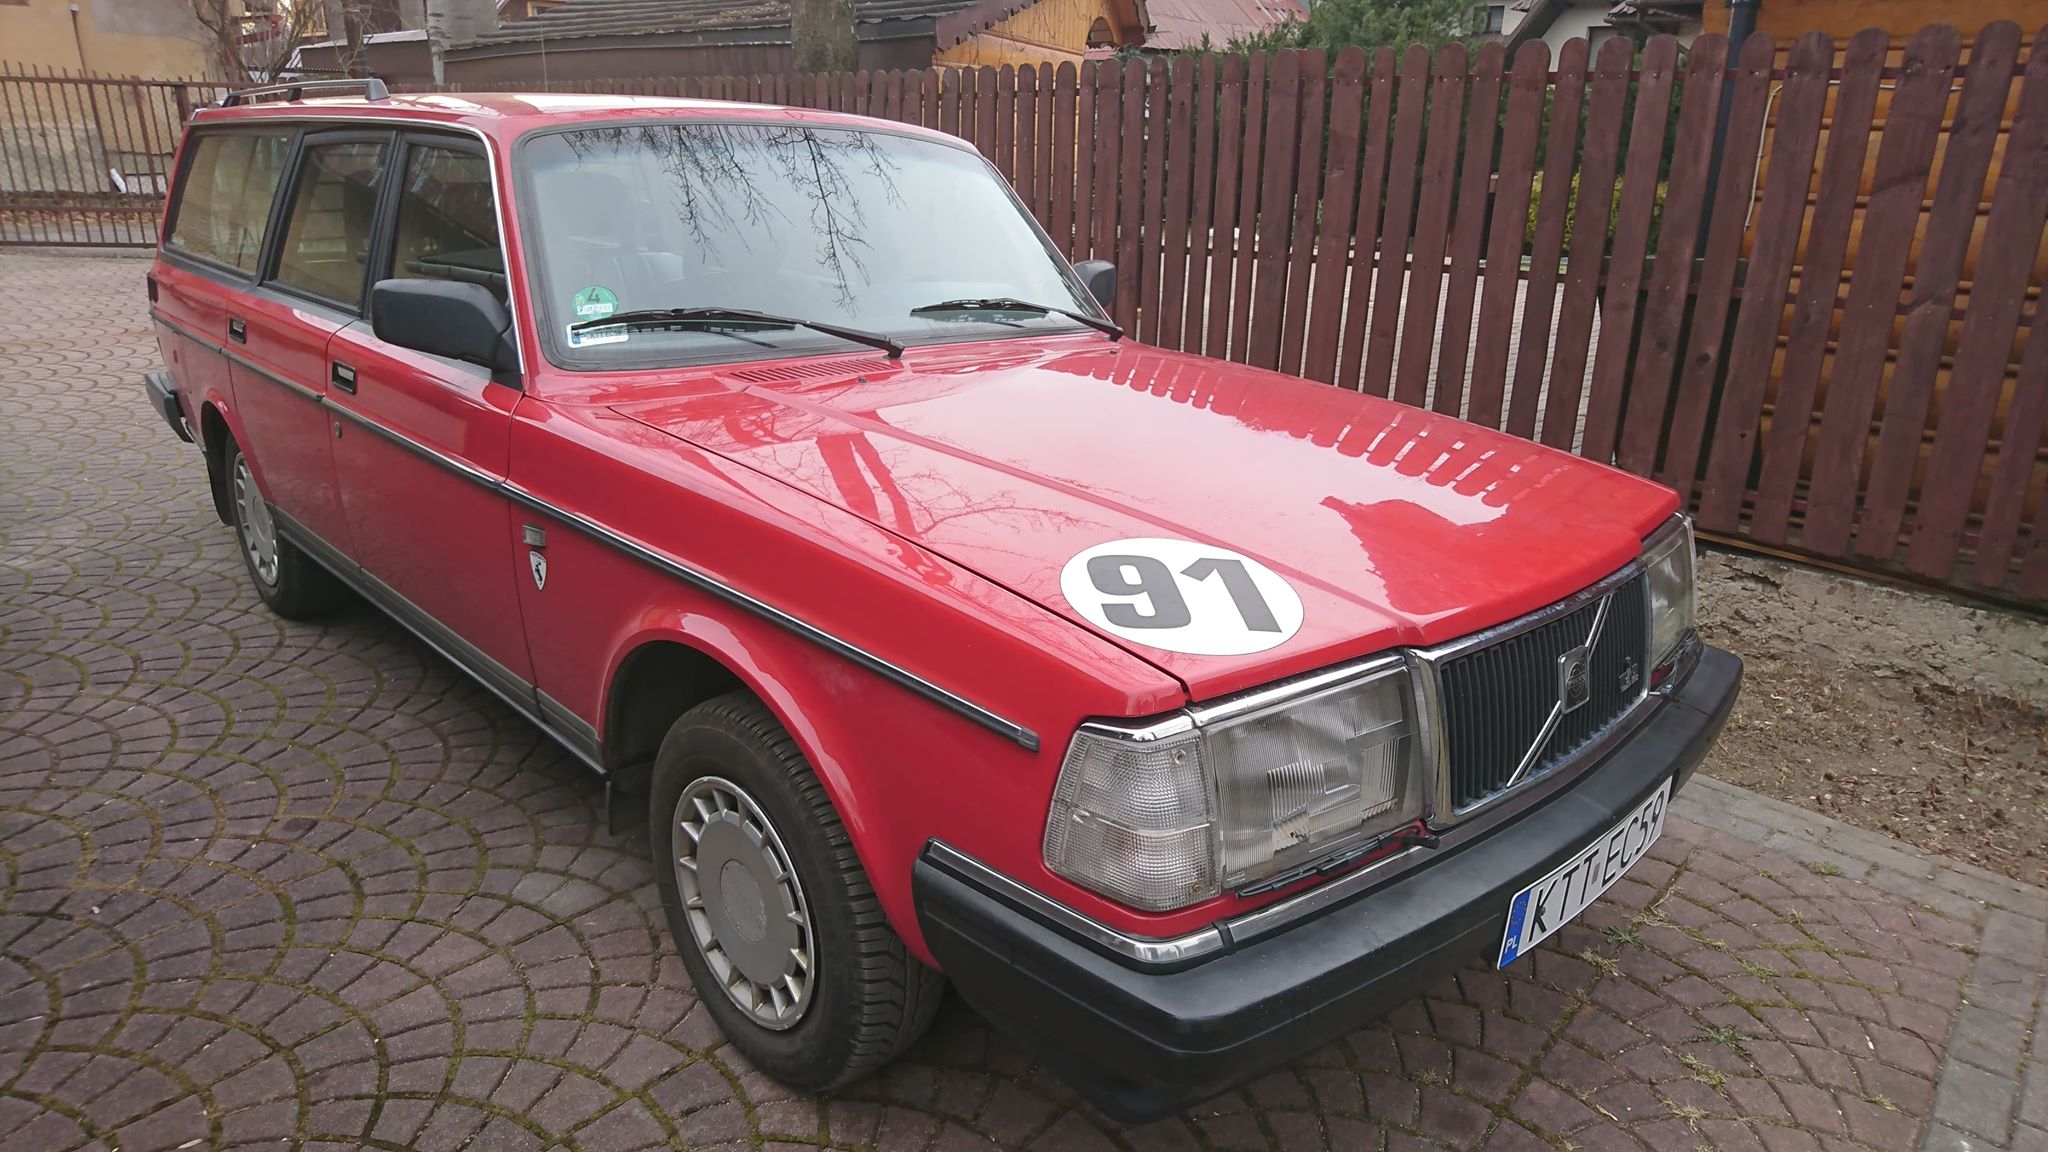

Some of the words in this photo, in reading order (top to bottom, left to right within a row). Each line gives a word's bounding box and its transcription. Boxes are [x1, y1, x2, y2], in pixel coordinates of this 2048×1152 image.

[588, 288, 600, 304] 4
[1087, 554, 1283, 633] 91
[1529, 850, 1600, 943] KTT
[1601, 789, 1665, 888] EC59
[1504, 935, 1518, 954] PL
